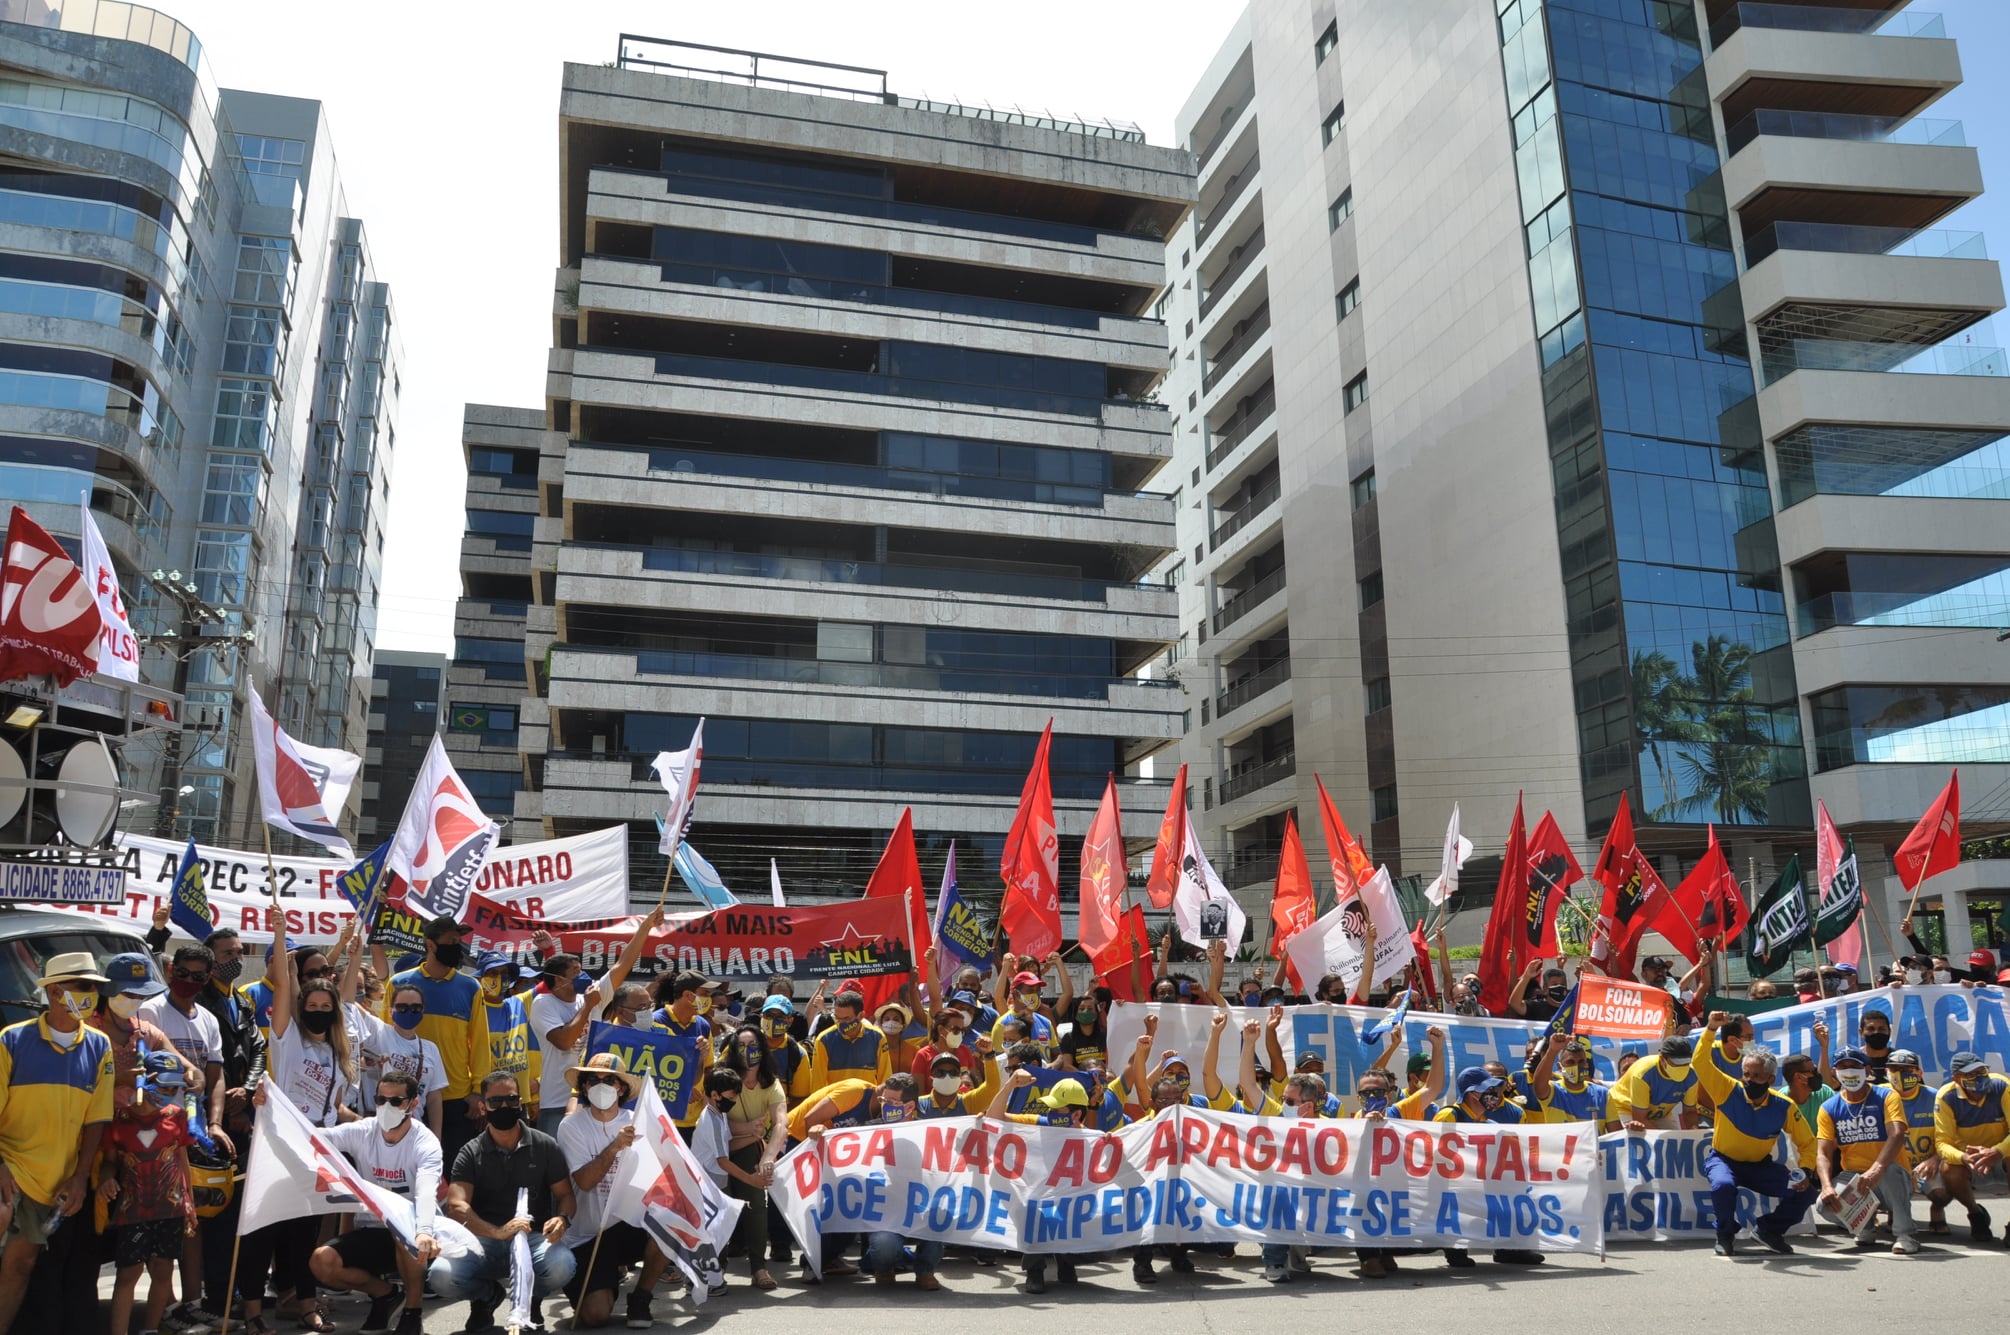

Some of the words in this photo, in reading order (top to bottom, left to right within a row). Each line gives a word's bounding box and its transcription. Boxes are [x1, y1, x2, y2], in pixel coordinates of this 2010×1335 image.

[62, 867, 122, 901] 8866.4797
[259, 866, 297, 898] 32
[1526, 889, 1540, 922] FNL
[379, 911, 425, 937] FNL
[726, 914, 793, 936] MAIS
[944, 925, 987, 958] CORREIOS
[828, 949, 878, 966] FNL
[1374, 946, 1393, 961] UFAL
[860, 967, 885, 975] CIDADE
[1605, 987, 1643, 1008] FORA
[1577, 1002, 1663, 1026] BOLSONARO
[609, 1042, 685, 1081] NÃO
[1292, 1014, 1385, 1097] EM
[658, 1078, 680, 1091] DOS
[887, 1109, 903, 1117] NÃO
[1052, 1116, 1070, 1124] NÃO
[1836, 1115, 1878, 1131] #NÃO
[1864, 1126, 1879, 1134] DOS
[793, 1129, 897, 1199] DIGA
[921, 1122, 1027, 1180] NÃO
[1046, 1137, 1124, 1188] AO
[1145, 1117, 1349, 1176] APAGÃO
[1371, 1126, 1578, 1182] POSTAL!
[903, 1181, 1011, 1236] PODE
[1024, 1177, 1207, 1244] IMPEDIR;
[1215, 1182, 1411, 1236] JUNTE-SE
[1436, 1191, 1461, 1235] A
[1485, 1186, 1580, 1239] NÓS.
